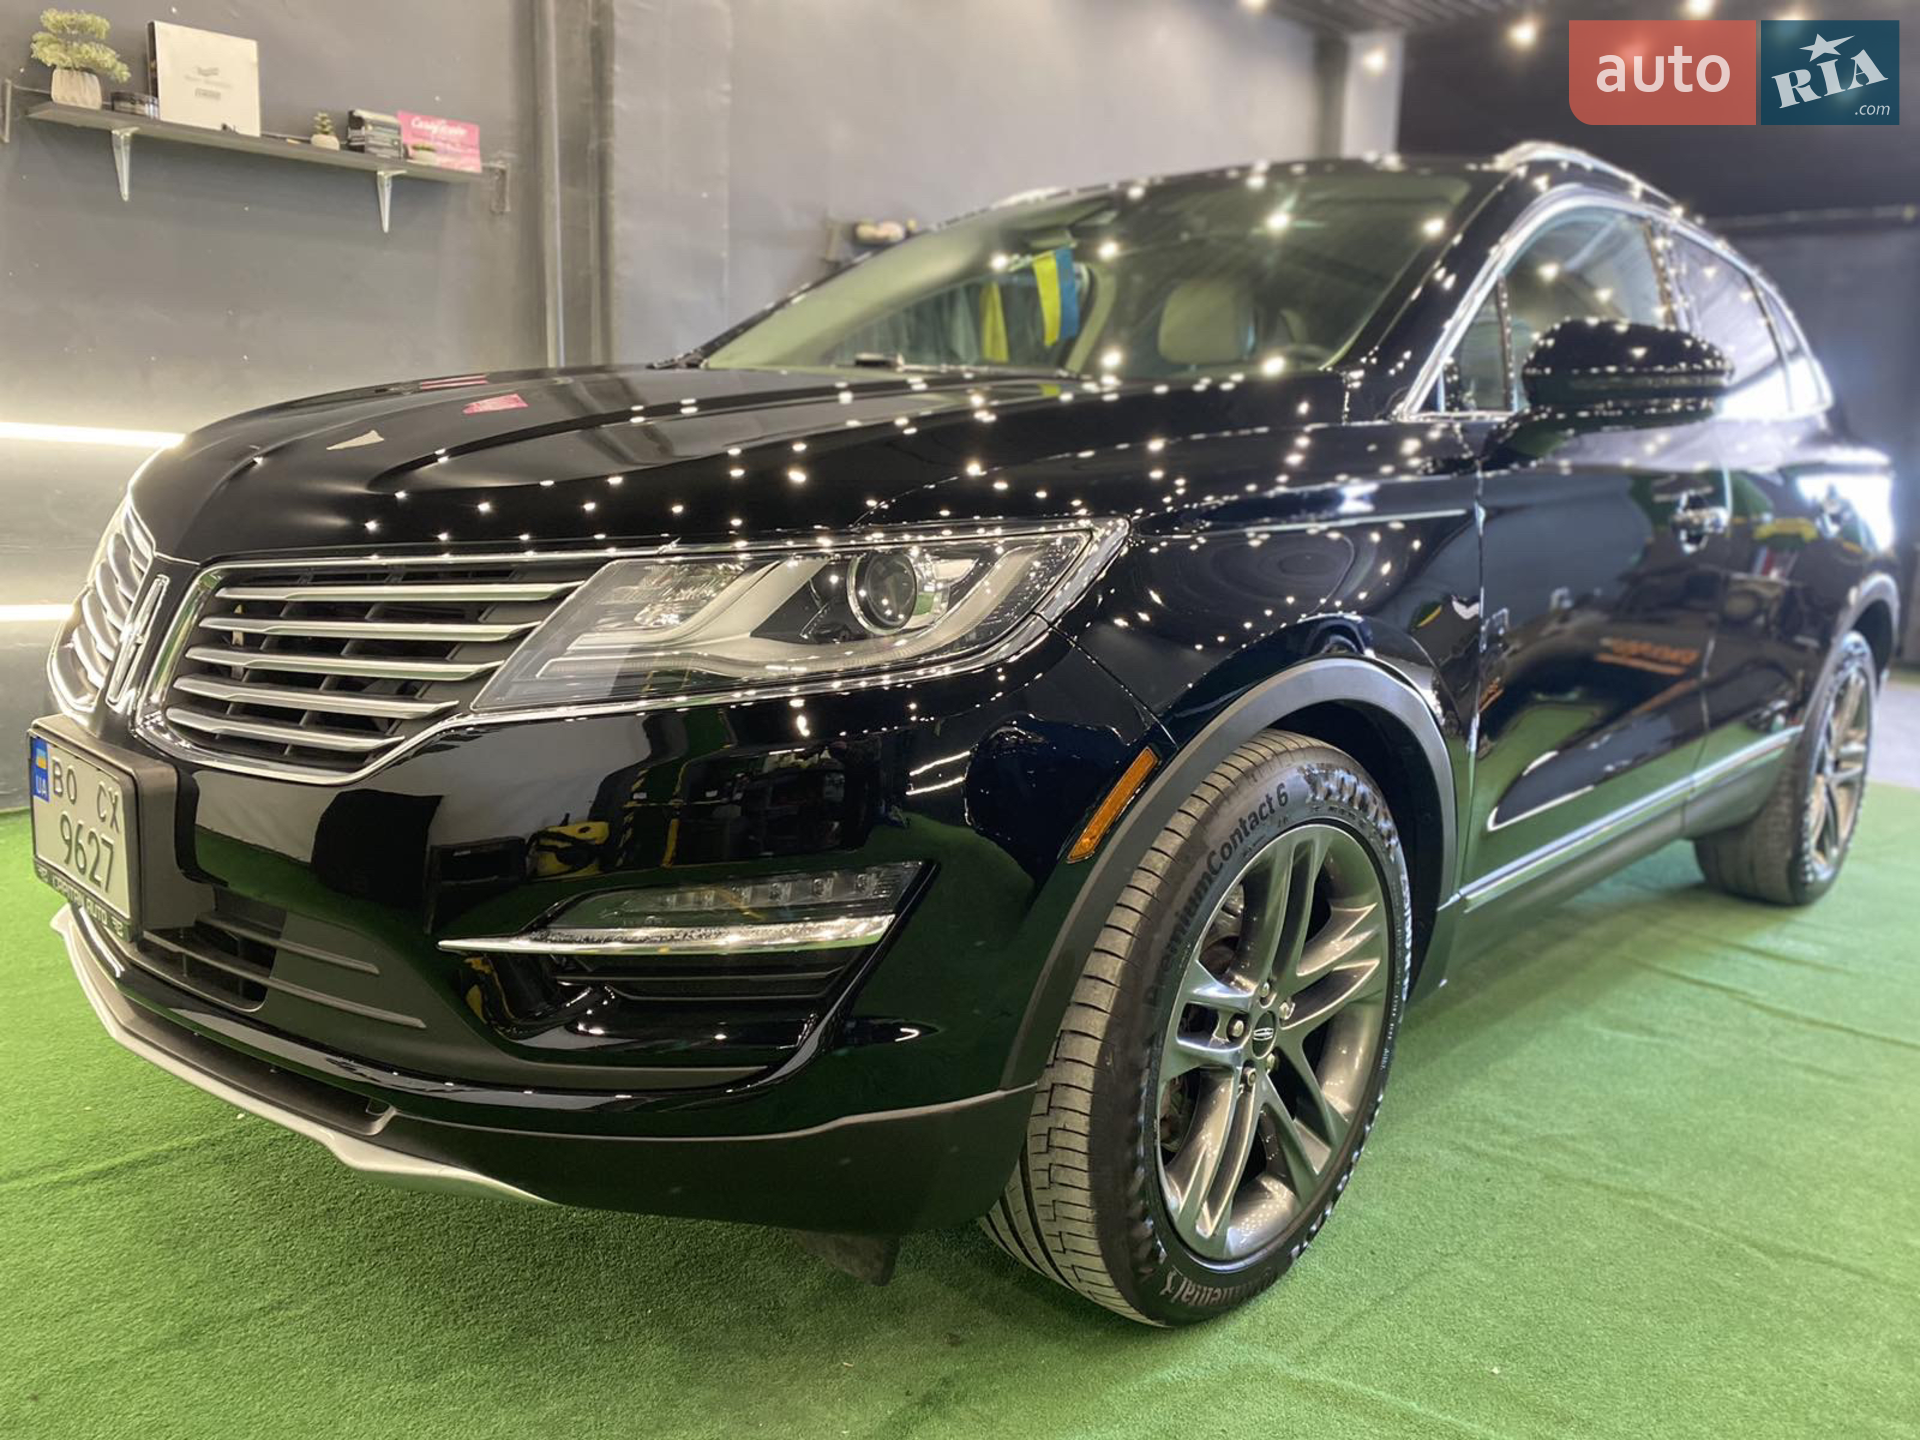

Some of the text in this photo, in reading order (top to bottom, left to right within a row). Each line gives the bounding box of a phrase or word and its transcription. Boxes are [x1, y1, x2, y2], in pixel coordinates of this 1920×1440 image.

[35, 774, 48, 797] UA
[52, 757, 120, 834] BO CX
[1276, 782, 1289, 807] 6
[60, 810, 114, 893] 9627
